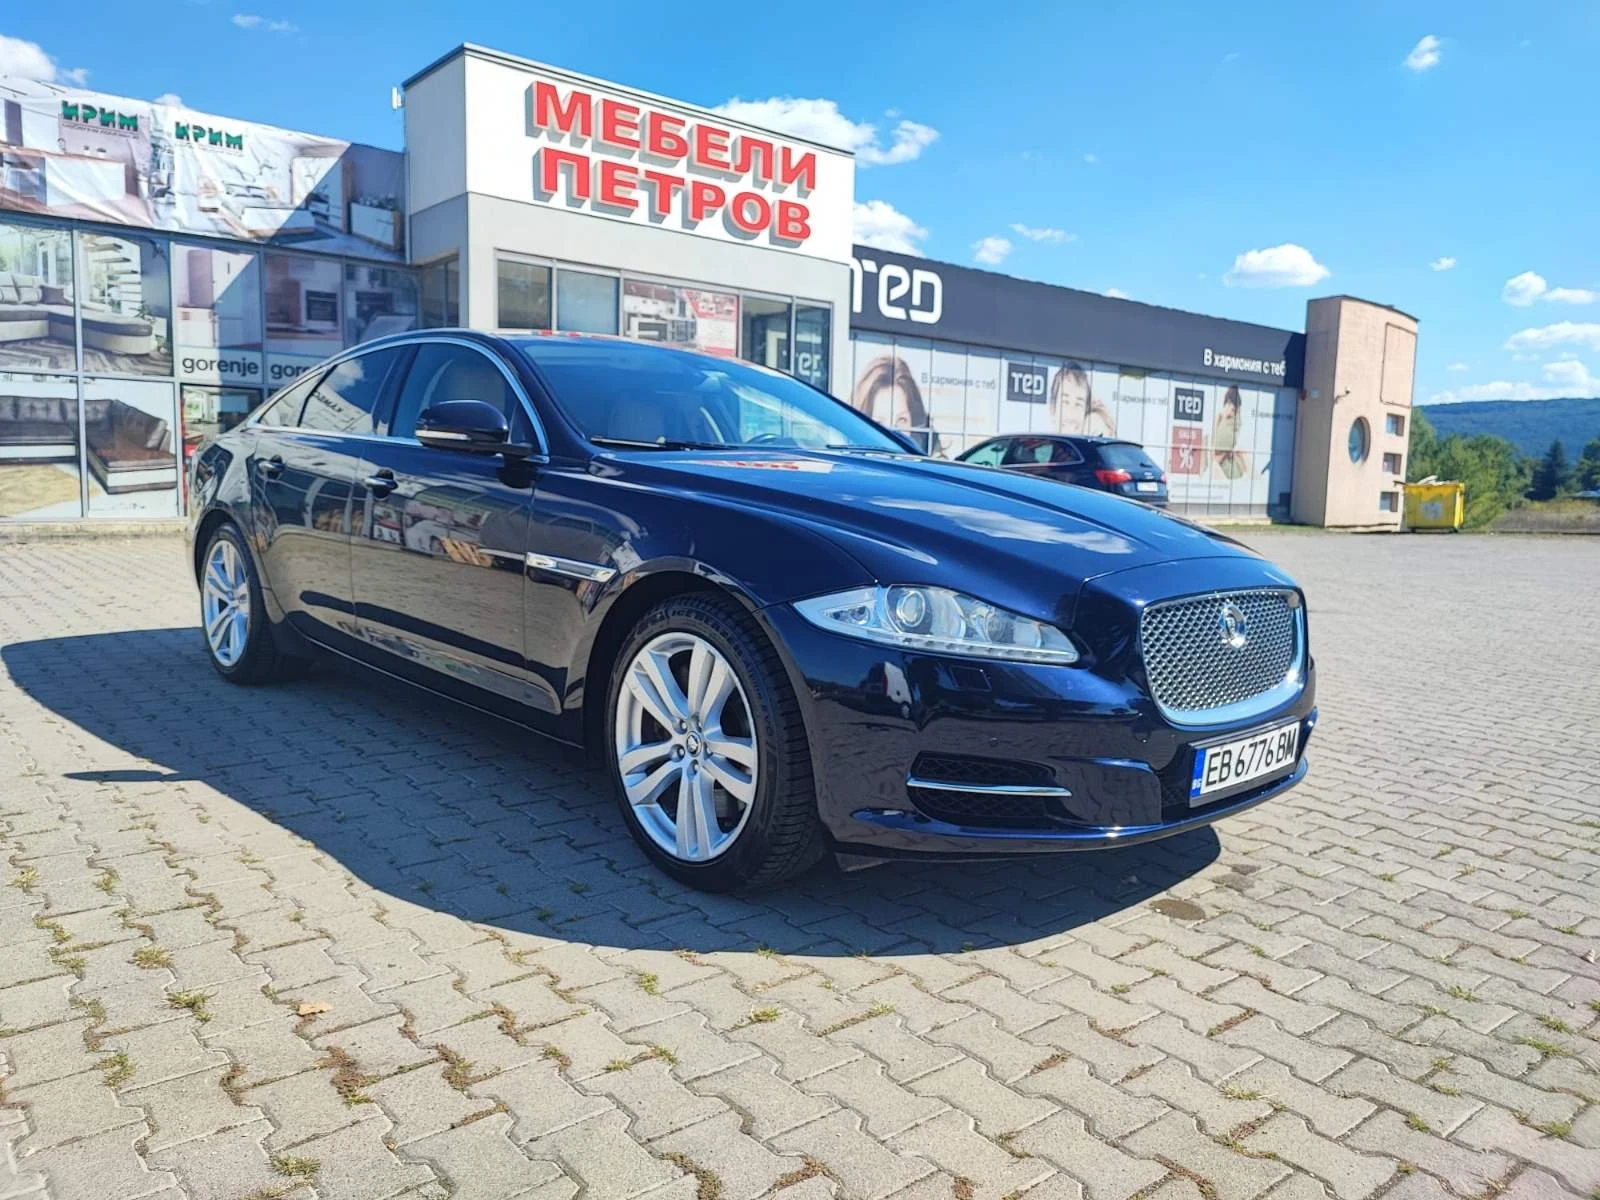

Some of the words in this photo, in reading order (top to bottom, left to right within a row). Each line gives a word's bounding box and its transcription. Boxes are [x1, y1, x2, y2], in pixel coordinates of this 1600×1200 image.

[529, 80, 816, 191] МЕБЕЛИ
[537, 146, 811, 241] ПЕТРОВ
[182, 357, 259, 377] gorenje
[1203, 348, 1213, 366] В
[1213, 353, 1262, 373] хармония
[1262, 361, 1270, 375] с
[1271, 360, 1286, 377] теб
[1234, 737, 1274, 777] 6776
